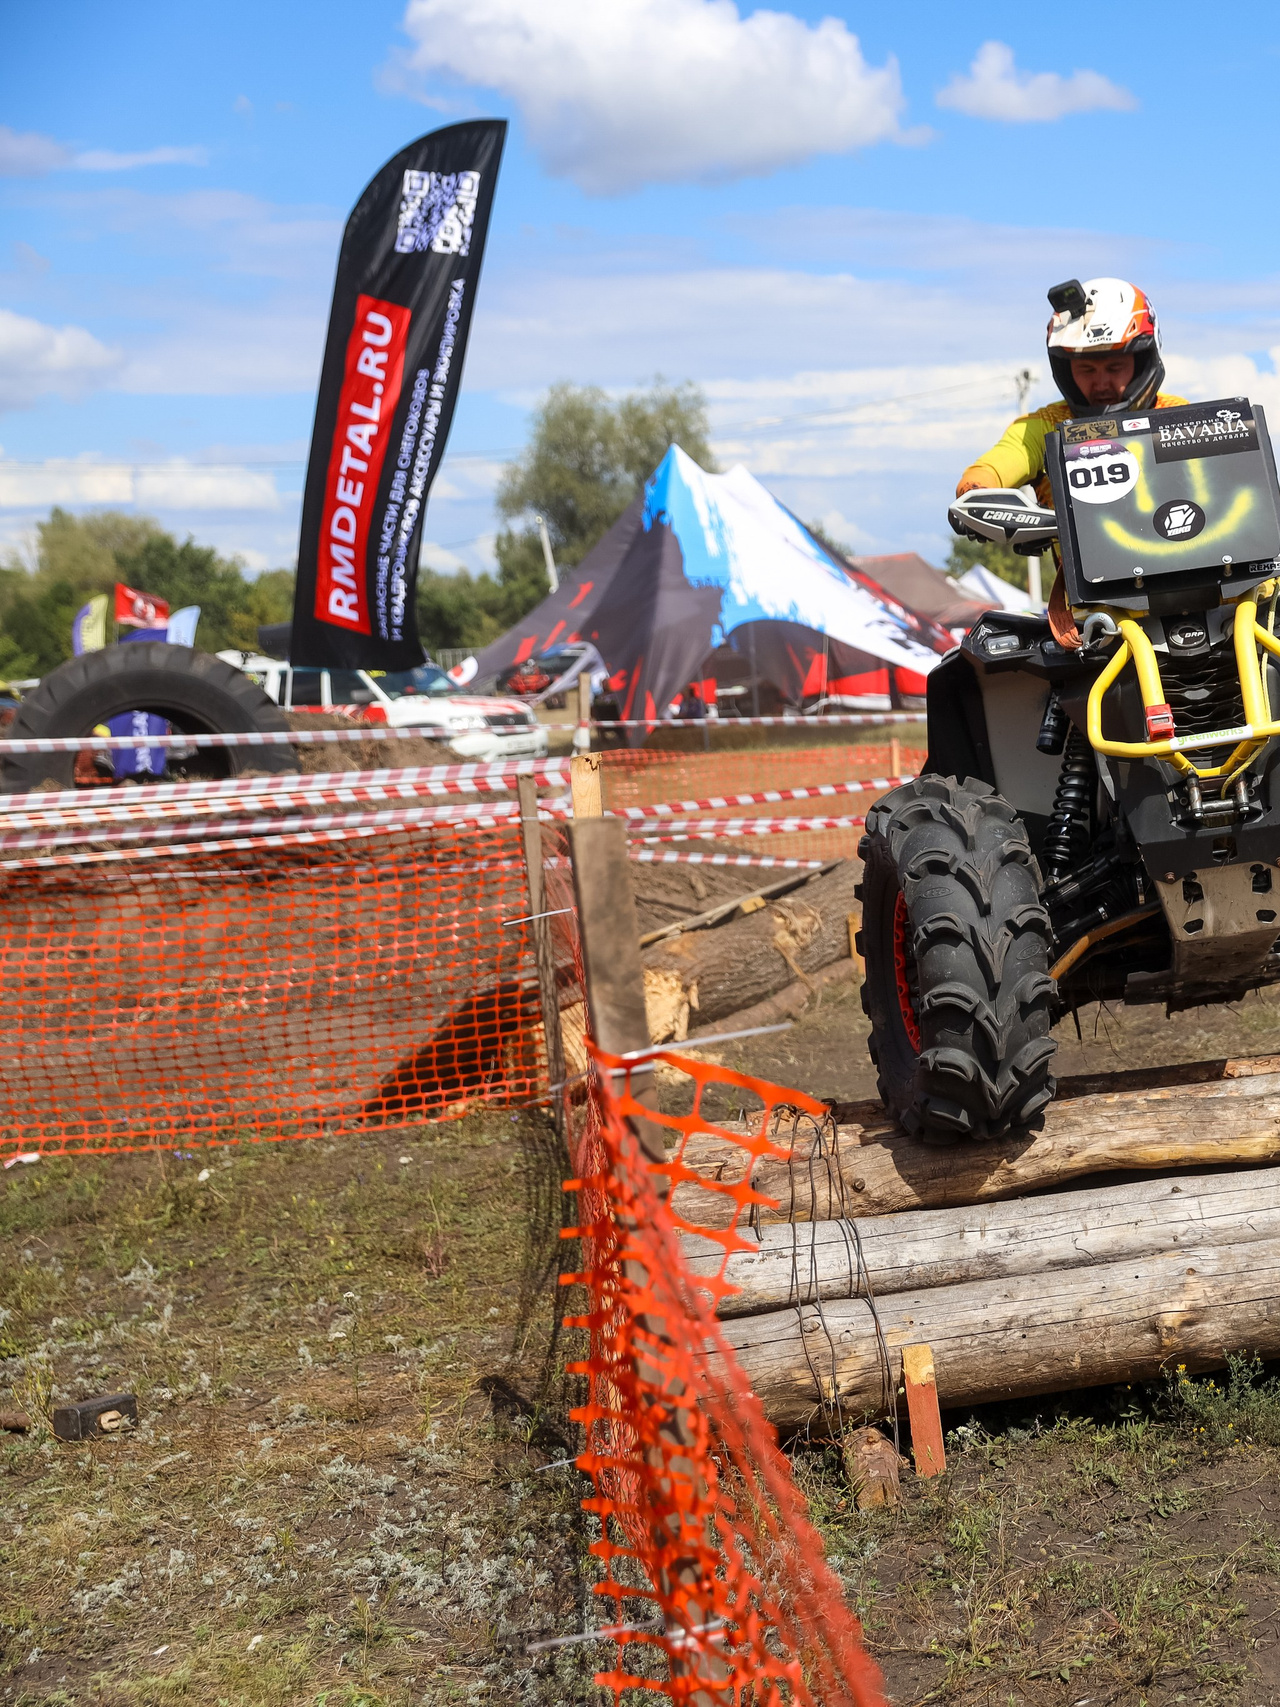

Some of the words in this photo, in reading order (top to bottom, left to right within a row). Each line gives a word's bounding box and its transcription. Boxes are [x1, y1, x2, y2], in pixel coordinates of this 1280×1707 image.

[432, 278, 466, 385] ЭКИПИРОВКА
[429, 383, 445, 399] И
[397, 368, 430, 469] СНЕГОХОДОВ
[1158, 418, 1249, 442] BAVARIA
[409, 399, 443, 499] АКСЕССУАРЫ
[1161, 437, 1202, 448] качество
[1213, 431, 1250, 442] деталях
[327, 311, 393, 622] RMDETAL.RU
[1069, 462, 1130, 489] 019
[389, 469, 408, 503] ДЛЯ
[378, 503, 400, 554] ЧАСТИ
[982, 510, 1041, 525] can-am
[391, 498, 421, 627] КВАДРОЦИКЛОВ
[375, 555, 390, 641] ЗАПАСНЫЕ
[391, 627, 404, 641] И
[1177, 726, 1244, 746] greenworks
